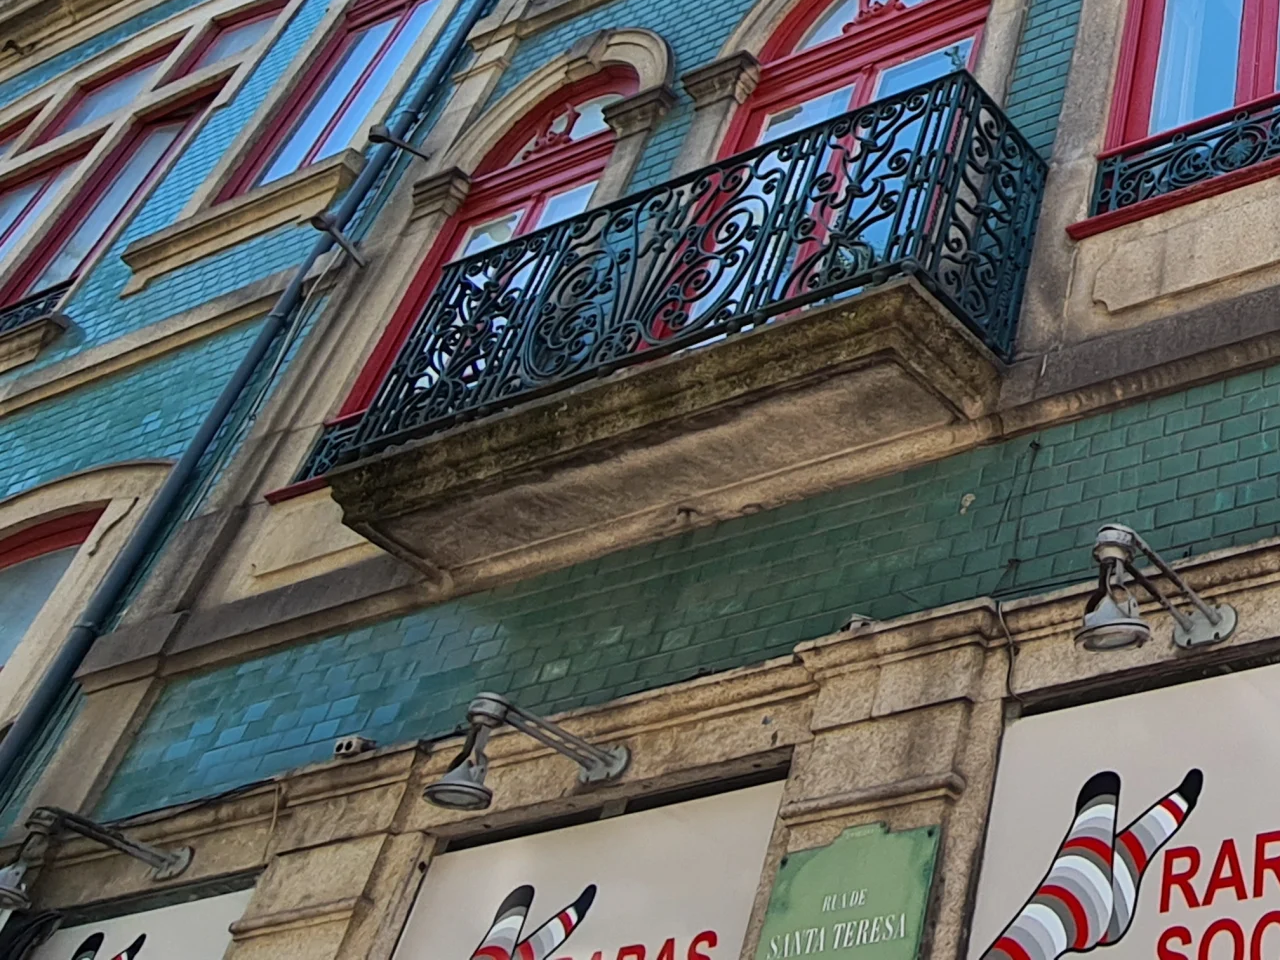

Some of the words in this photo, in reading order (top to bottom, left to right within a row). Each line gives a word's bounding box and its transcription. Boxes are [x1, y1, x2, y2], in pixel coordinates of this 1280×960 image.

[822, 893, 847, 912] RUA
[849, 888, 868, 907] DE
[767, 927, 826, 960] SANTA
[832, 912, 907, 951] TERESA
